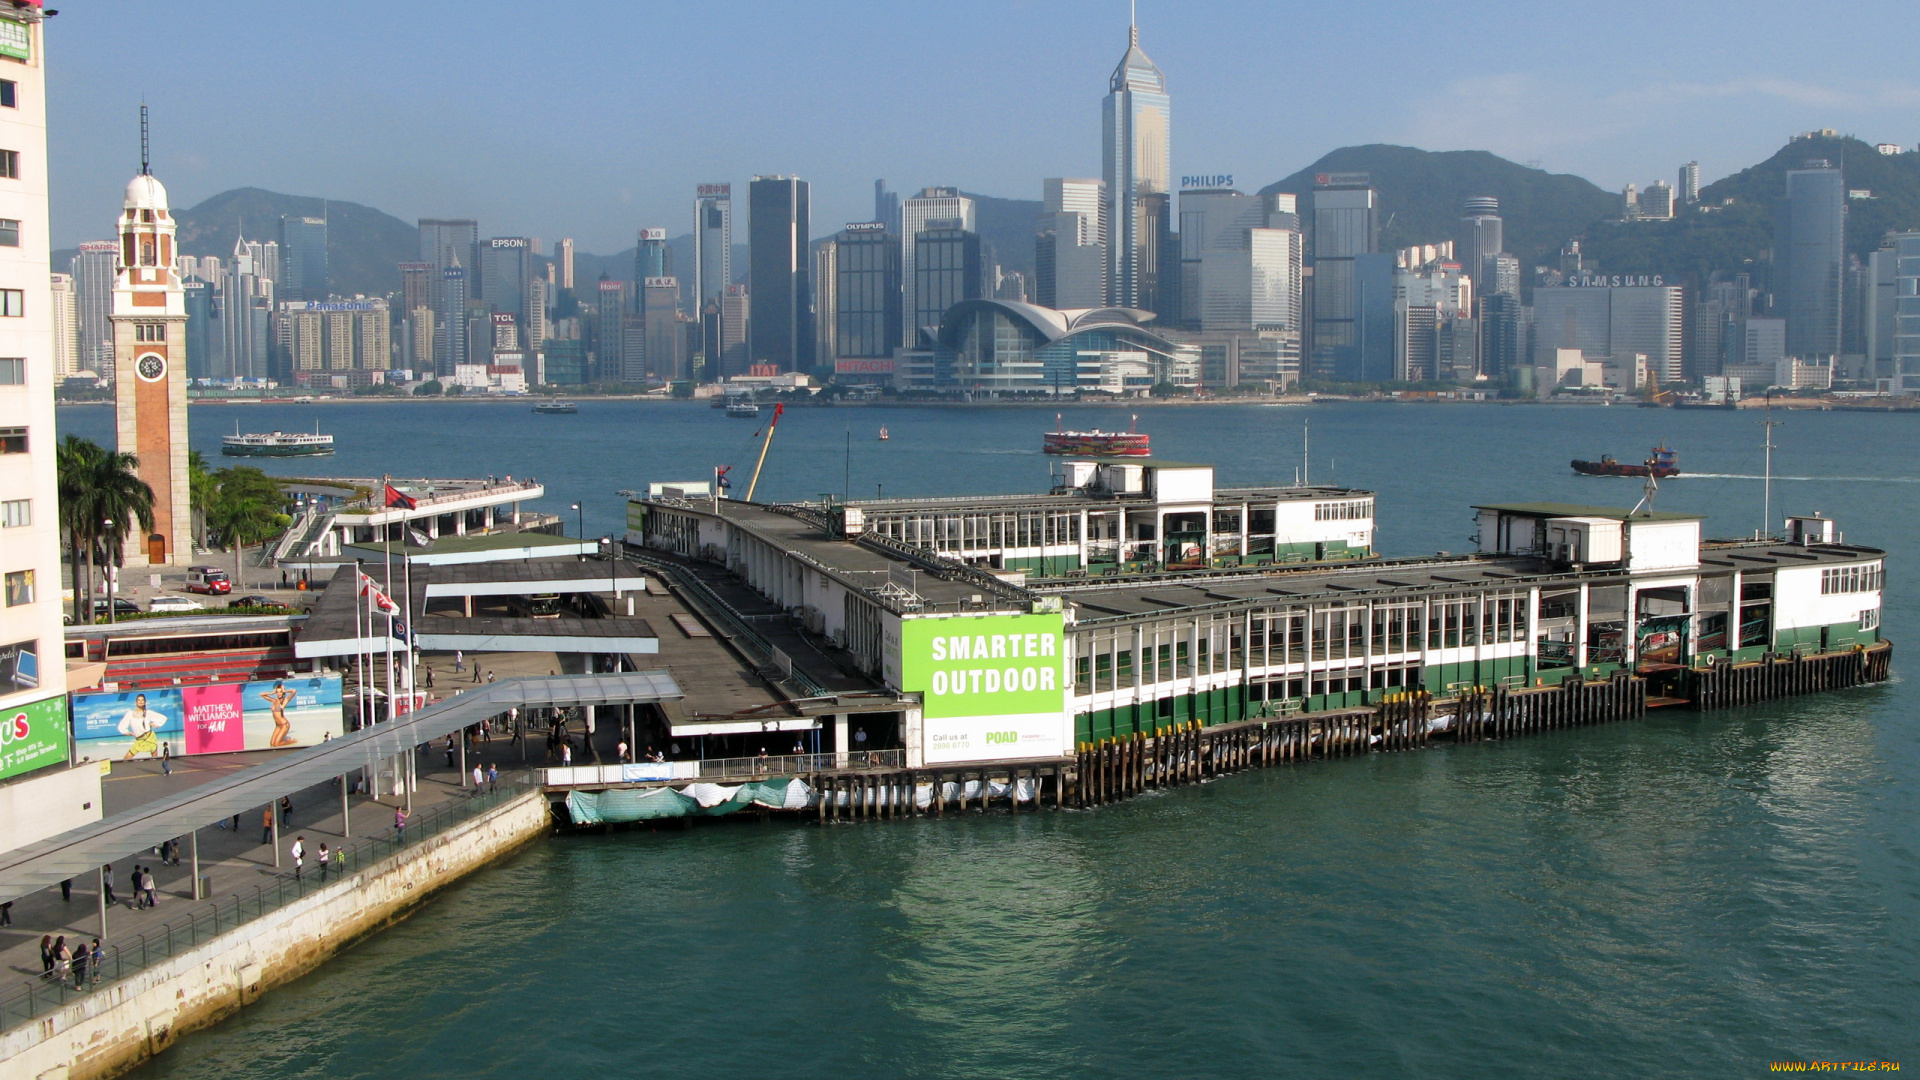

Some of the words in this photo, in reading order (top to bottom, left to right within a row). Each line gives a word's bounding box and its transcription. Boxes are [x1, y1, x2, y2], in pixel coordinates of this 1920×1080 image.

[1181, 175, 1234, 188] PHILIPS
[492, 239, 523, 248] EPSON
[600, 282, 621, 290] Haier
[1569, 275, 1662, 288] SAMSUNG
[306, 301, 373, 311] Panasonic
[494, 314, 515, 322] TCL
[488, 365, 518, 374] MGM
[750, 365, 778, 377] ITAT
[836, 360, 895, 372] HITACHI
[932, 633, 1056, 661] SMARTER
[932, 666, 1056, 696] OUTDOOR
[193, 703, 233, 714] MATTHEW
[188, 710, 240, 722] WILLIAMSON
[208, 720, 226, 733] H&M
[932, 734, 948, 742] Call
[986, 731, 1018, 744] POAD
[39, 742, 58, 755] Terminal
[952, 741, 970, 749] 8770
